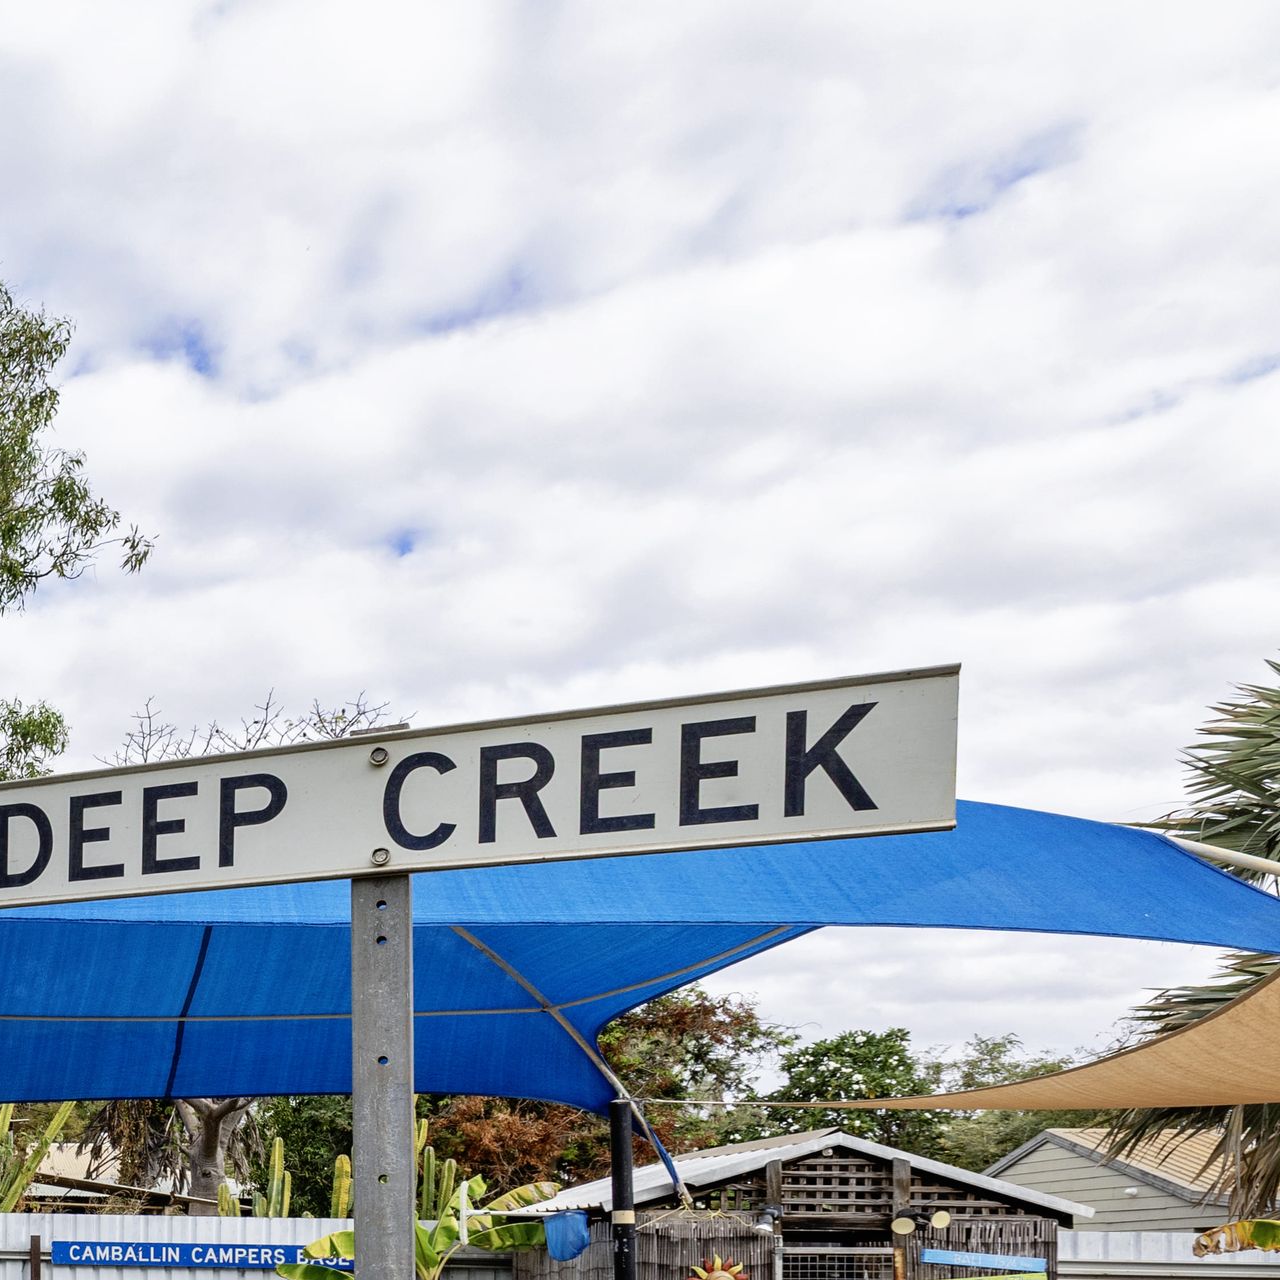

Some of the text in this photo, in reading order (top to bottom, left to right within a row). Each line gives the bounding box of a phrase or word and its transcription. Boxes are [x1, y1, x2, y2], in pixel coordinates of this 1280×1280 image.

[383, 701, 880, 851] CREEK
[69, 1245, 180, 1263] CAMBALLIN
[191, 1247, 286, 1264] CAMPERS
[954, 1254, 982, 1265] BALI
